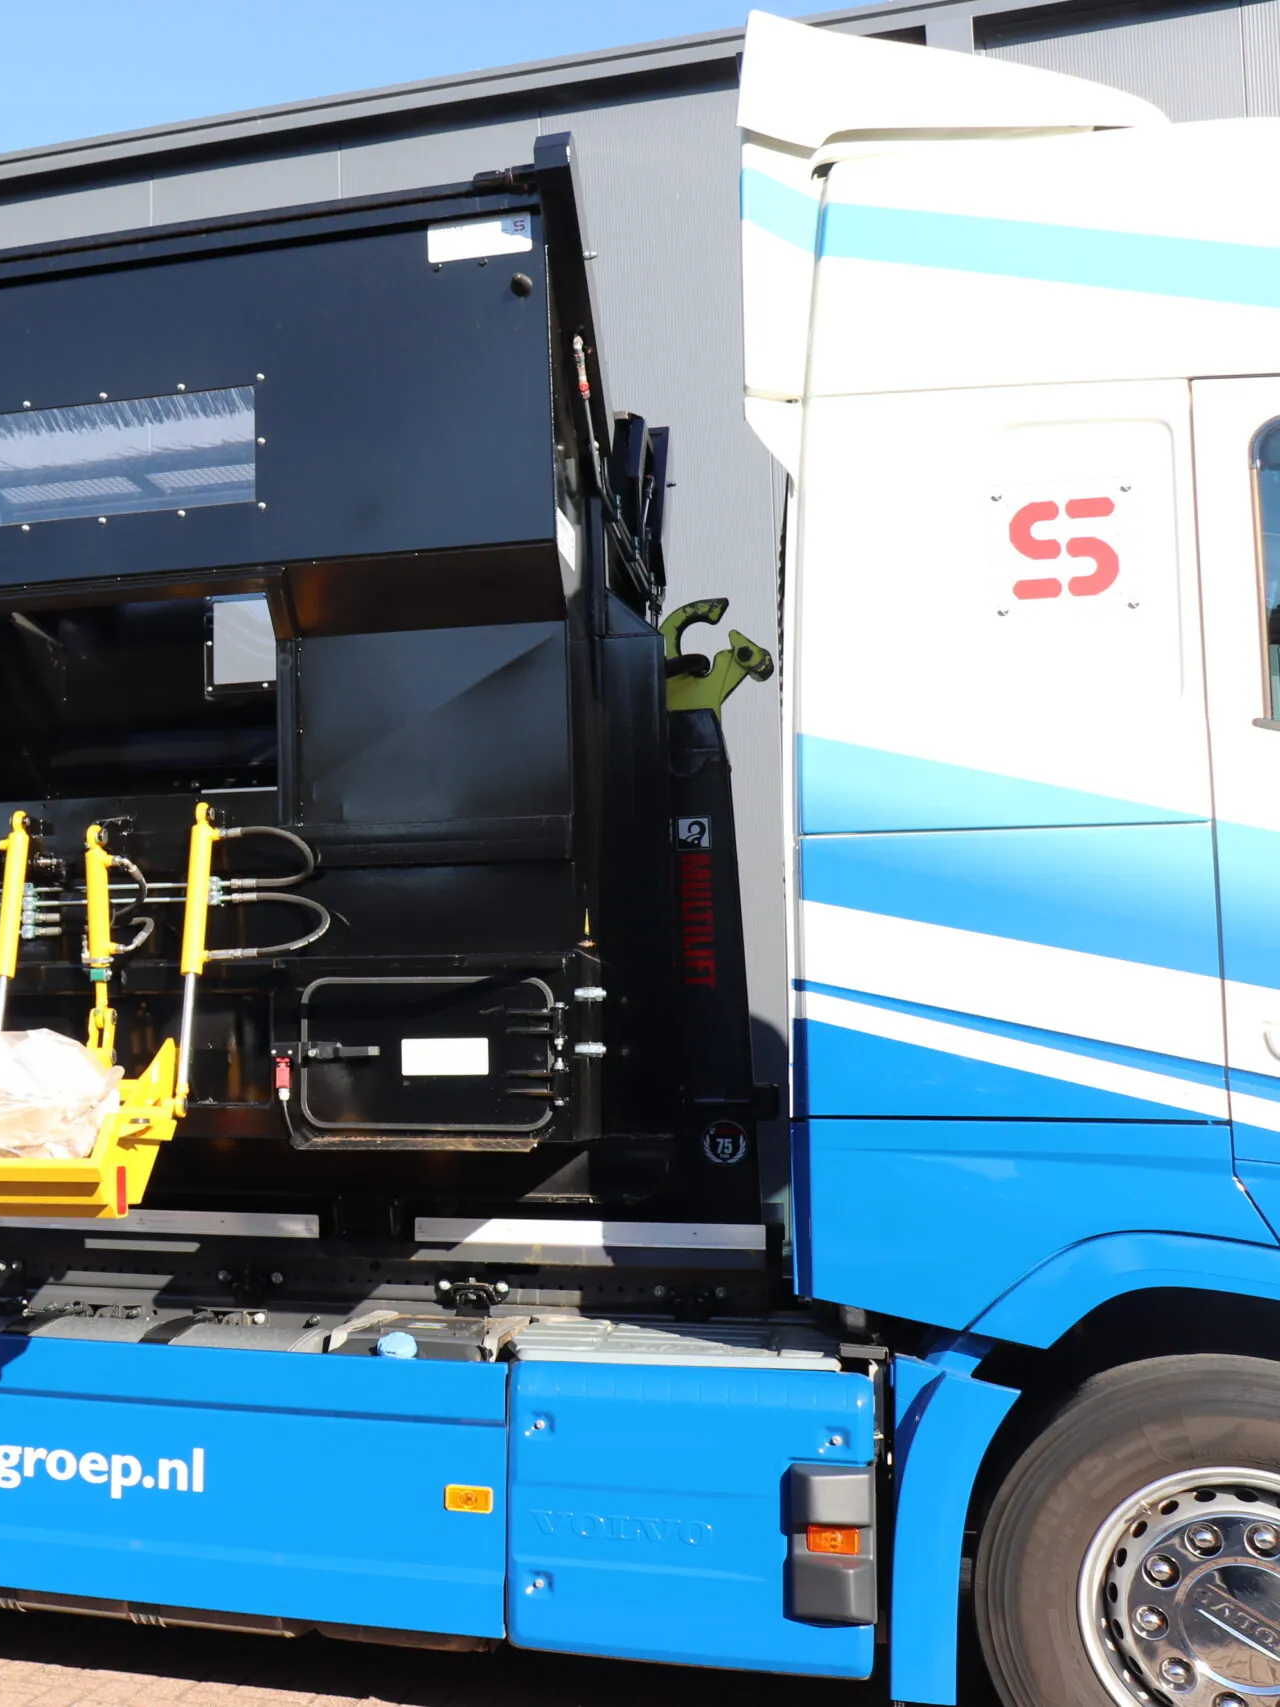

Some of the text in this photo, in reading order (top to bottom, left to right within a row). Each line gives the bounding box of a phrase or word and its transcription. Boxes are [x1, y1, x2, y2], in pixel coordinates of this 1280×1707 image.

[679, 852, 716, 989] MULTILIFT
[715, 1137, 733, 1154] 75
[526, 1508, 714, 1547] VOLVO
